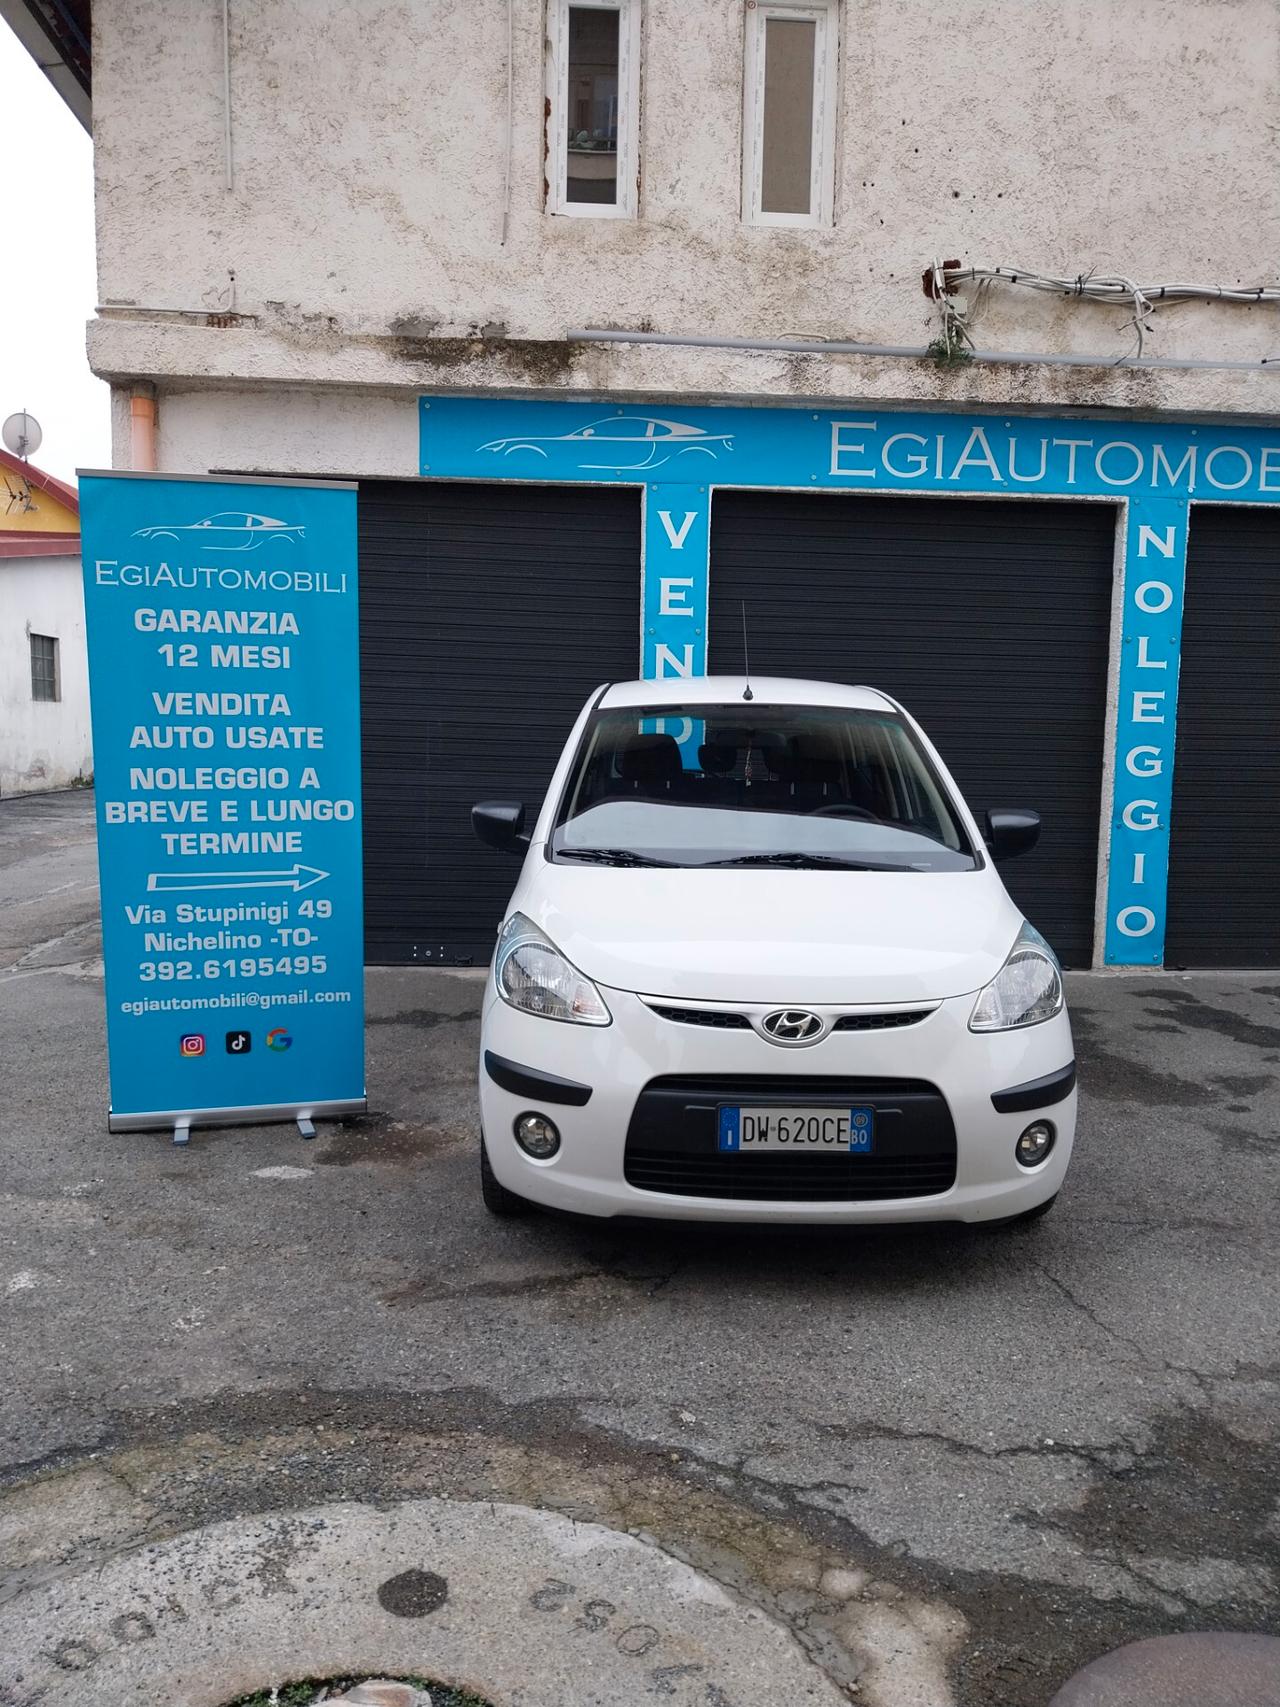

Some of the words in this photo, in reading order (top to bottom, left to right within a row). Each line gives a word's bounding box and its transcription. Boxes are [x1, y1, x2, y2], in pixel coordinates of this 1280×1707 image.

[134, 608, 300, 635] GARANZIA
[158, 644, 198, 667] 12
[211, 645, 290, 669] MESI
[152, 692, 291, 716] VENDITA
[129, 726, 214, 749] AUTO
[226, 726, 324, 749] USATE
[1115, 525, 1177, 938] NOLEGGIO
[130, 767, 289, 790] NOLEGGIO
[299, 767, 320, 789] A
[105, 800, 208, 824] BREVE
[220, 800, 238, 822] E
[250, 799, 355, 821] LUNGO
[161, 831, 302, 855] TERMINE
[125, 905, 166, 925] Via
[176, 901, 289, 926] Stupinigi
[298, 900, 332, 918] 49
[144, 931, 262, 952] Nichelino
[139, 955, 327, 981] 392.6195495
[121, 989, 351, 1016] egiautomobili@gmail.com
